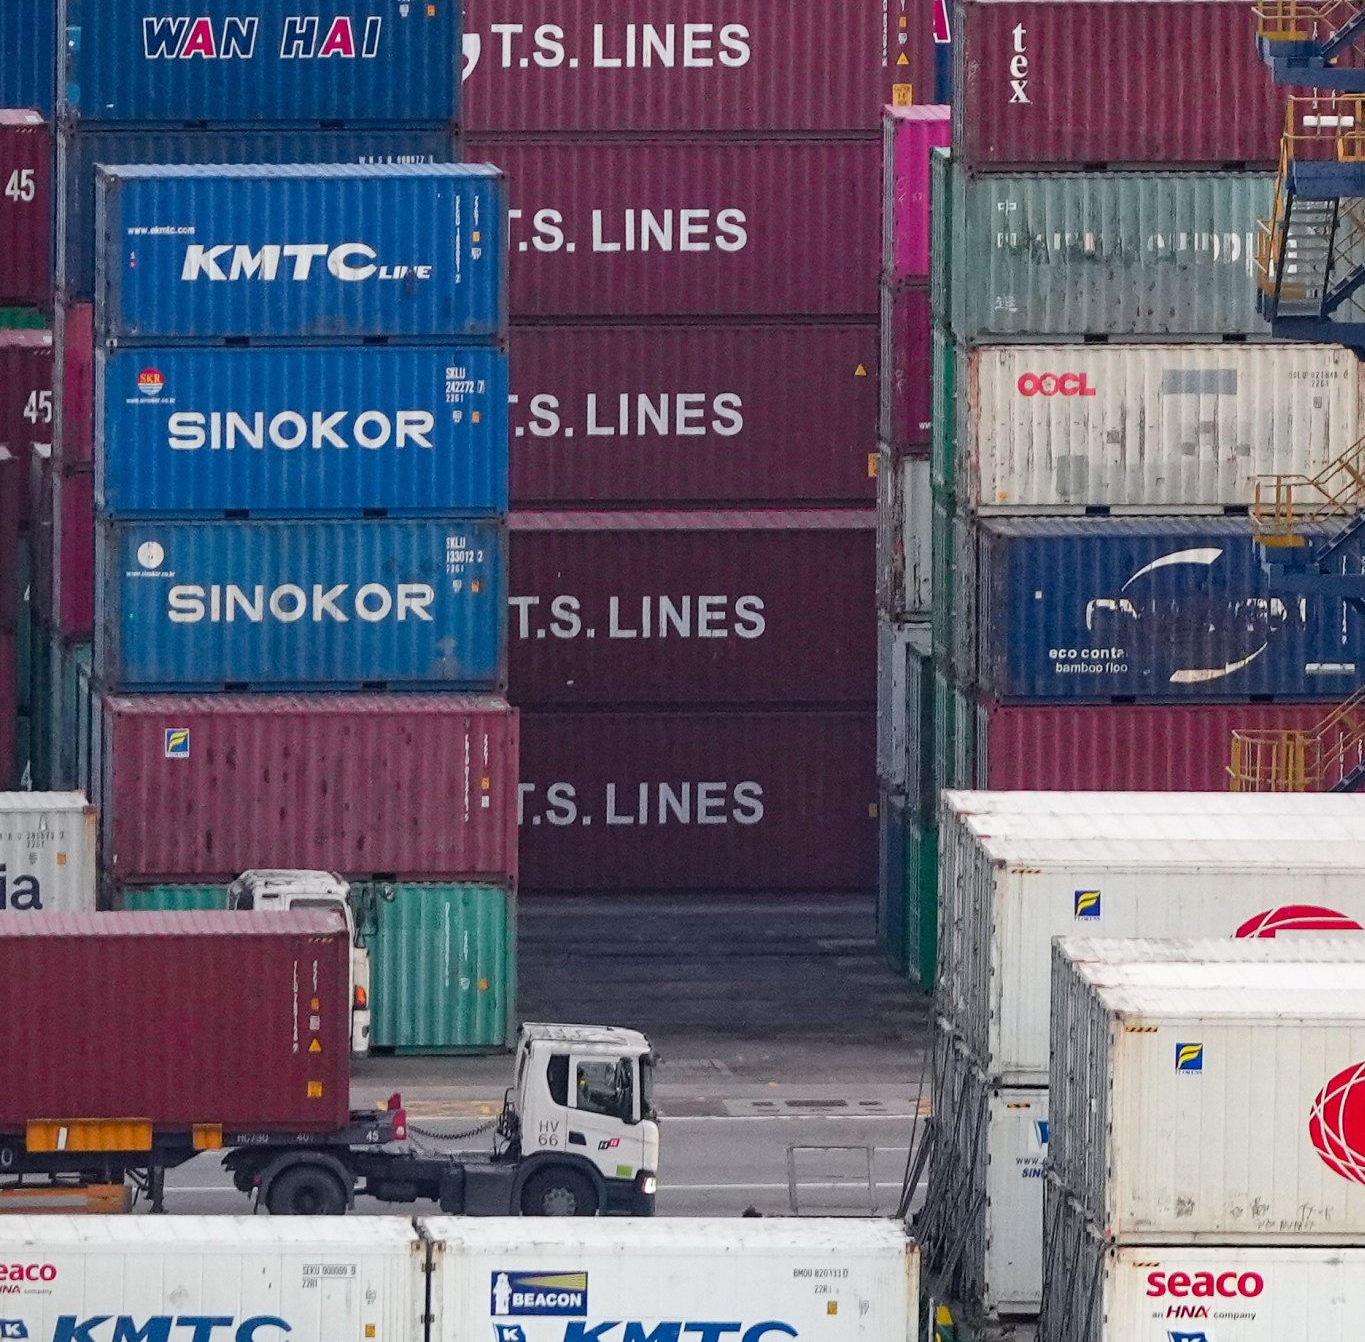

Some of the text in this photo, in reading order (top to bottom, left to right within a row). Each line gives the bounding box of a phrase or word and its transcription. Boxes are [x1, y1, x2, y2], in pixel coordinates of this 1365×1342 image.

[143, 16, 383, 59] WAN HAI
[490, 23, 751, 68] T.S. LINES
[1008, 22, 1031, 105] tex
[5, 168, 36, 202] 45
[591, 208, 748, 254] LINES
[180, 242, 378, 282] KMTC
[445, 367, 466, 380] SKLU
[445, 380, 475, 394] 242272
[1018, 372, 1097, 397] OOCL
[23, 389, 53, 425] 45
[586, 392, 744, 438] LINES
[168, 409, 435, 450] SINOKOR
[168, 583, 435, 624] SINOKOR
[609, 595, 766, 639] LINES
[1048, 648, 1077, 659] eco
[1056, 661, 1103, 673] bamboo
[606, 781, 765, 827] LINES
[537, 1134, 559, 1146] 66
[538, 1120, 560, 1133] HV
[793, 1268, 813, 1278] BMOU
[1146, 1271, 1264, 1298] seaco
[512, 1293, 582, 1308] BEACON
[1213, 1310, 1257, 1321] company
